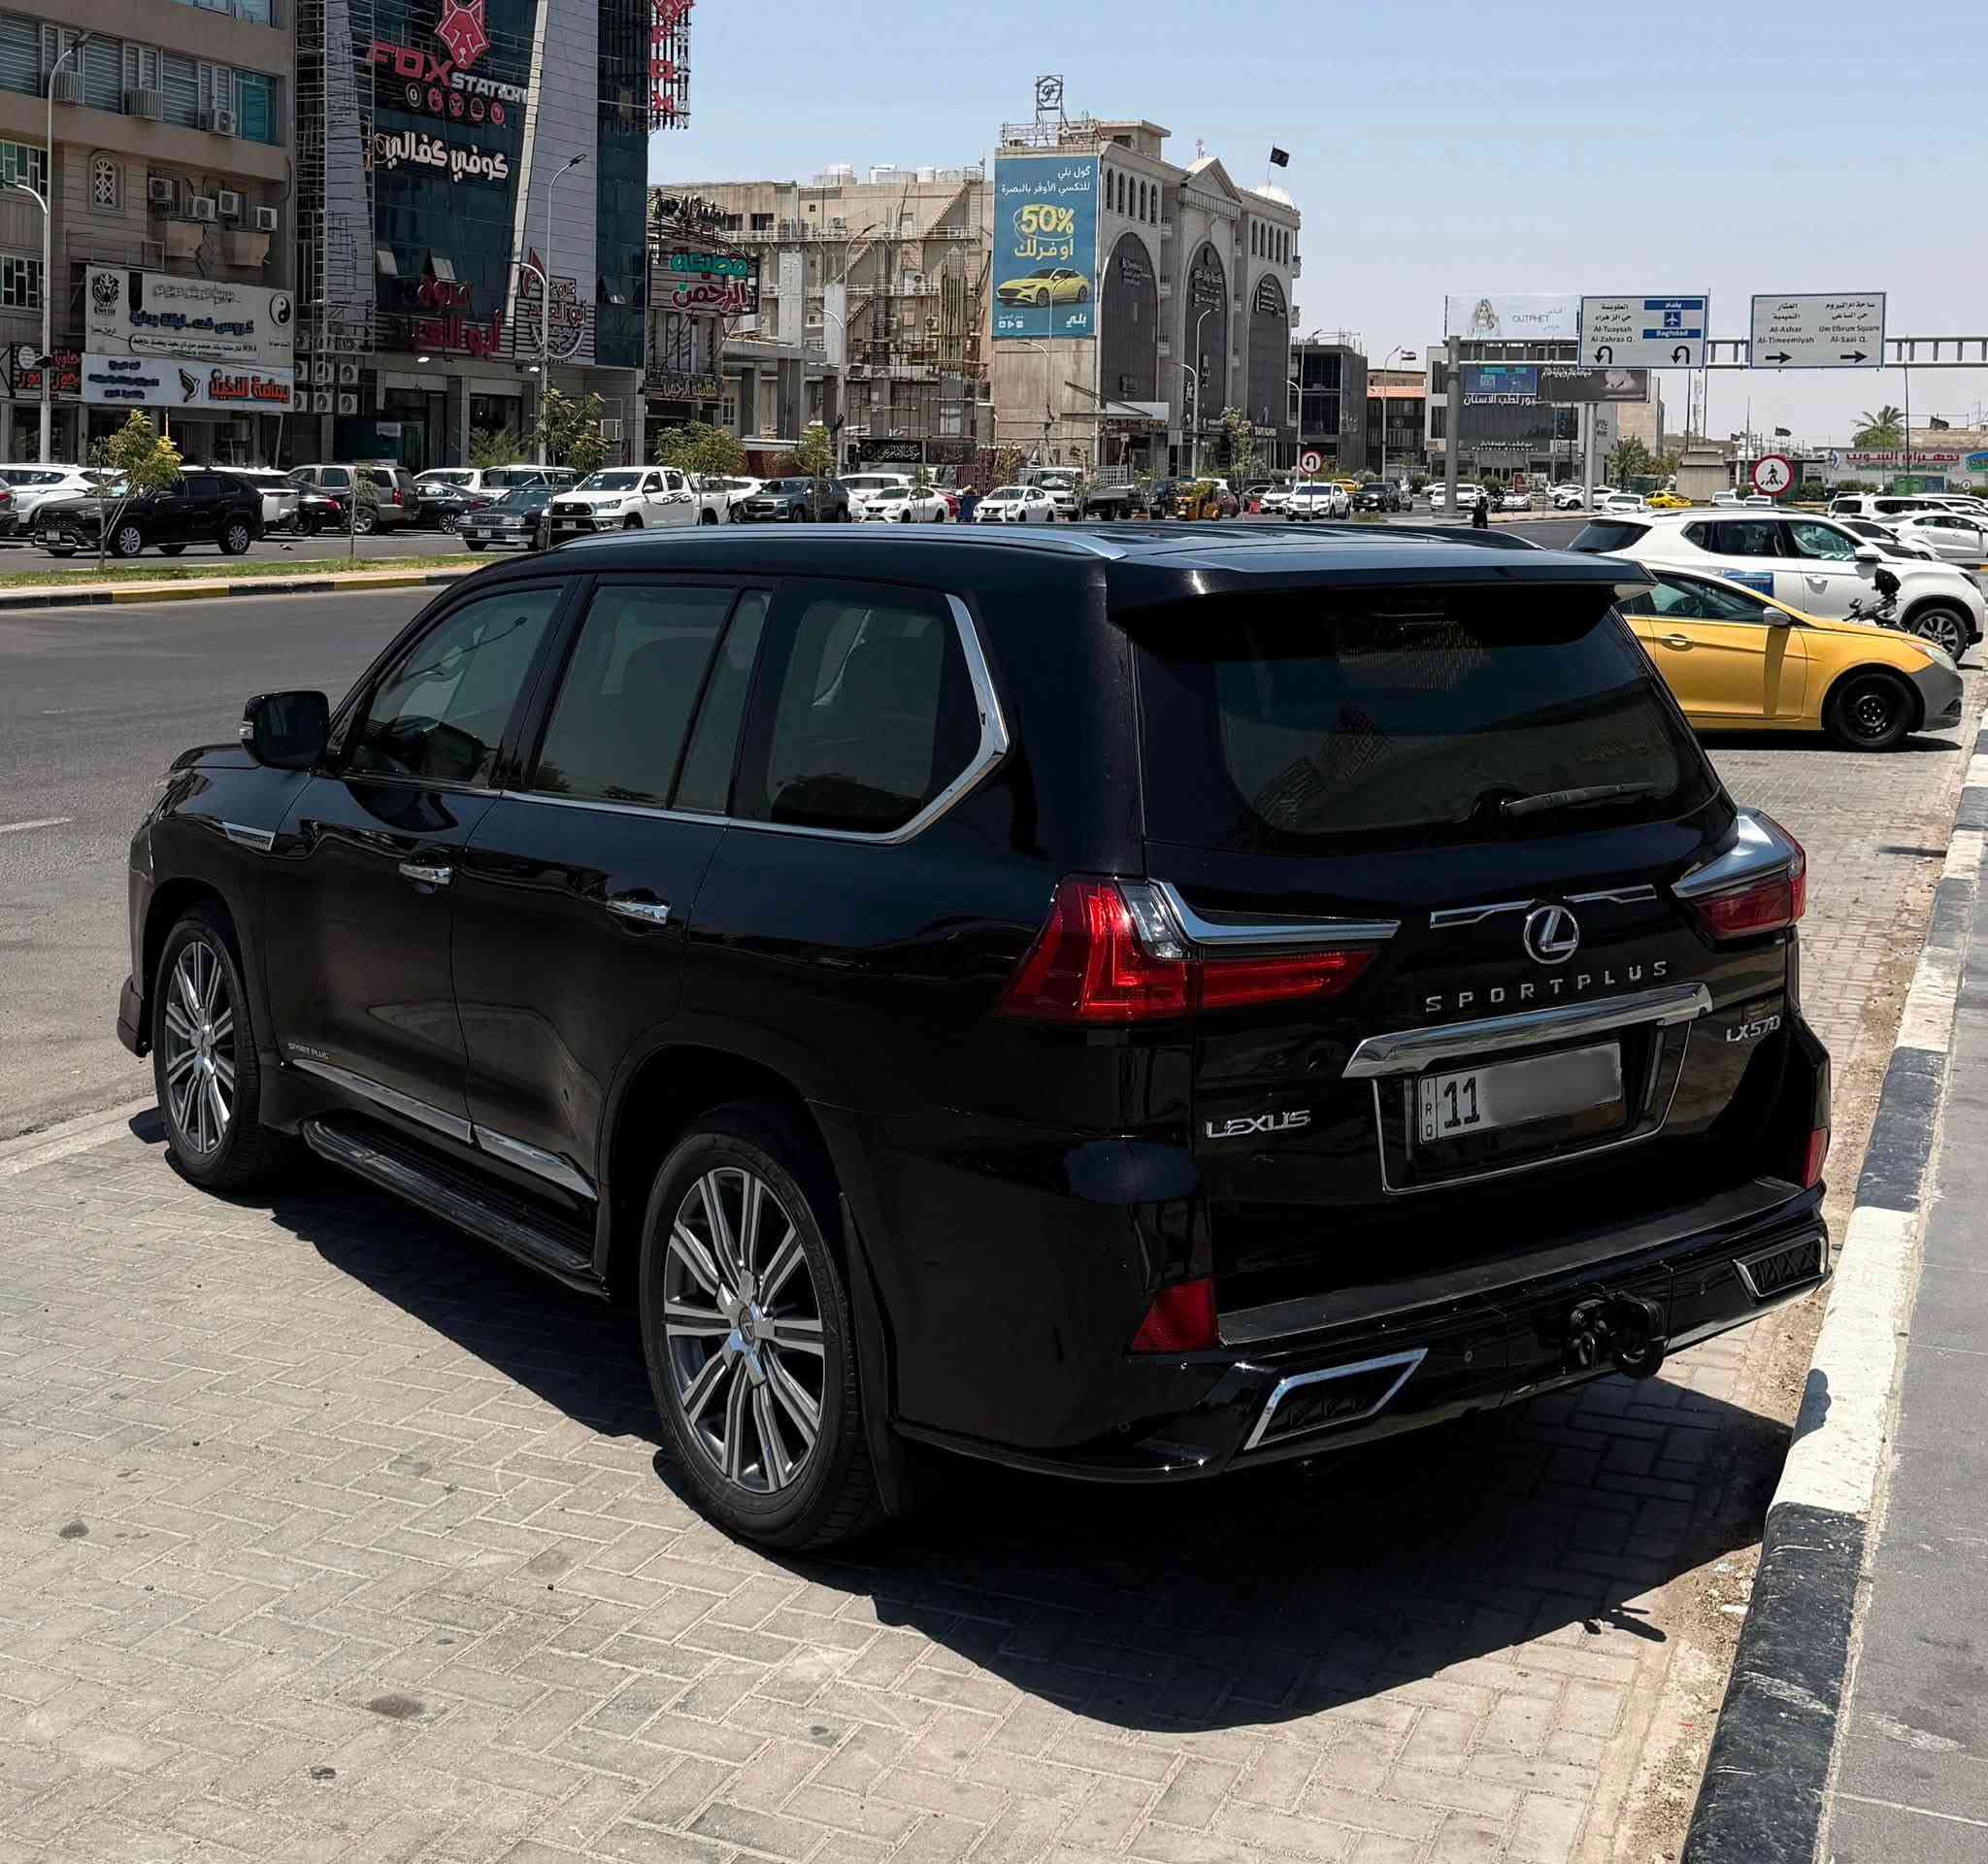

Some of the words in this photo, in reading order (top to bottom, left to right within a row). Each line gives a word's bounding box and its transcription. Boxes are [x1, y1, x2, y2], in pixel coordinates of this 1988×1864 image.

[366, 40, 453, 88] FOX
[451, 71, 529, 105] STATION
[450, 145, 509, 183] كوفي
[1019, 206, 1075, 234] 50%
[672, 281, 747, 313] الرحمن
[1656, 329, 1689, 338] Baghdad
[1856, 324, 1880, 334] Square
[1442, 1077, 1481, 1128] 11
[1205, 1110, 1312, 1140] LEXUS
